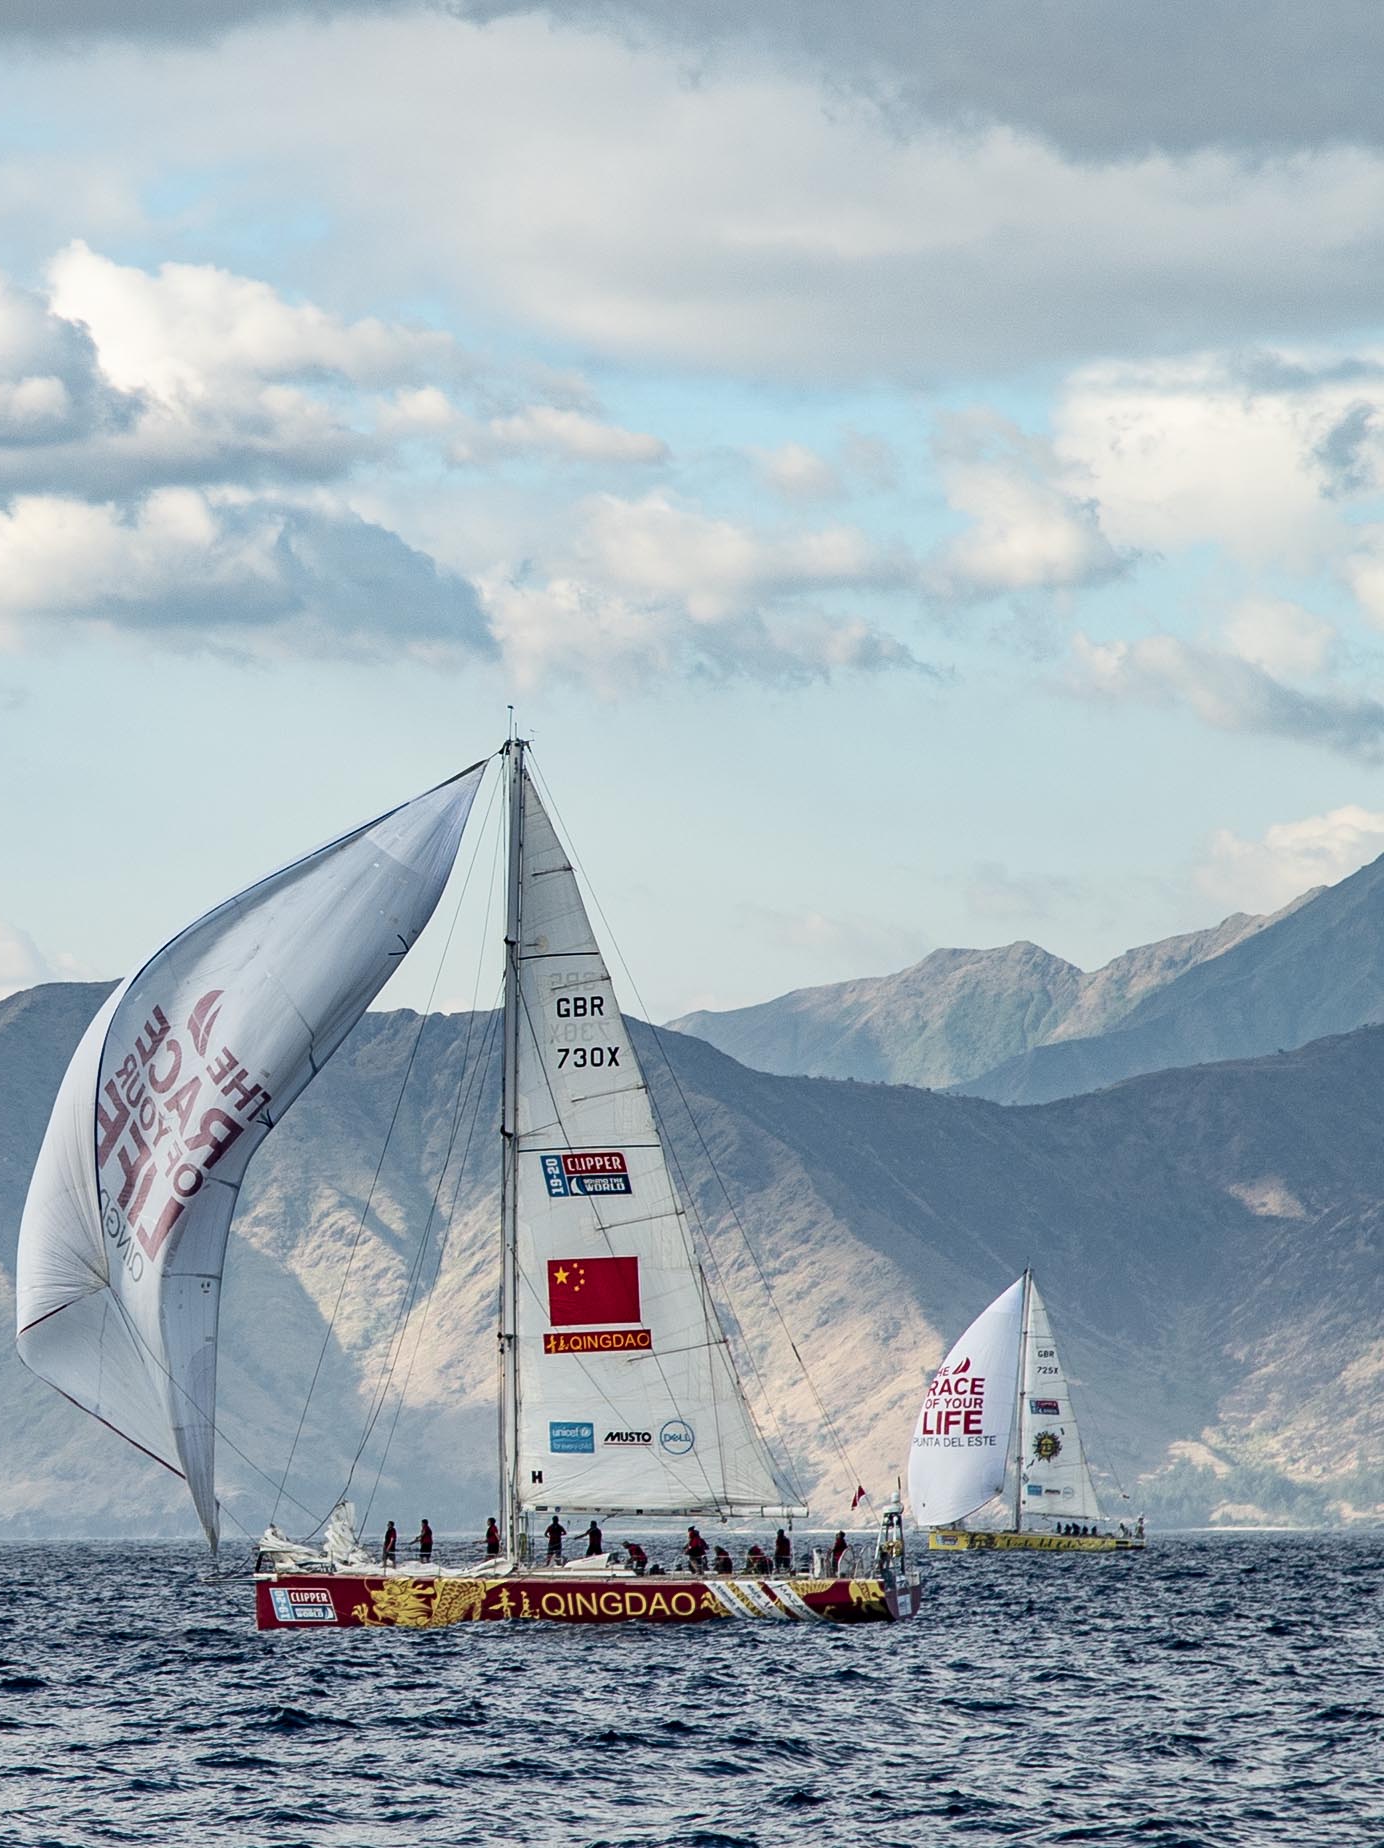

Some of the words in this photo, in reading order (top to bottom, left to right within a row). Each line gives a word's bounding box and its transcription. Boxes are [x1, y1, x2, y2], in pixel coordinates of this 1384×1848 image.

[556, 995, 605, 1018] GBR
[557, 1046, 620, 1069] 730X
[566, 1156, 622, 1171] CLIPPER
[545, 1158, 565, 1194] 19-20
[584, 1182, 626, 1192] WORLD
[569, 1332, 650, 1351] QINGDAO
[1037, 1350, 1055, 1358] GBR
[938, 1366, 950, 1377] HE
[926, 1377, 986, 1398] RACE
[925, 1398, 940, 1410] OF
[943, 1397, 984, 1409] YOUR
[922, 1410, 983, 1435] LIFE
[603, 1431, 652, 1443] MUSTO
[663, 1433, 692, 1442] DELL
[943, 1437, 965, 1448] DEL
[967, 1435, 997, 1447] ESTE
[290, 1591, 329, 1603] CLIPPER
[541, 1591, 697, 1618] QINGDAO
